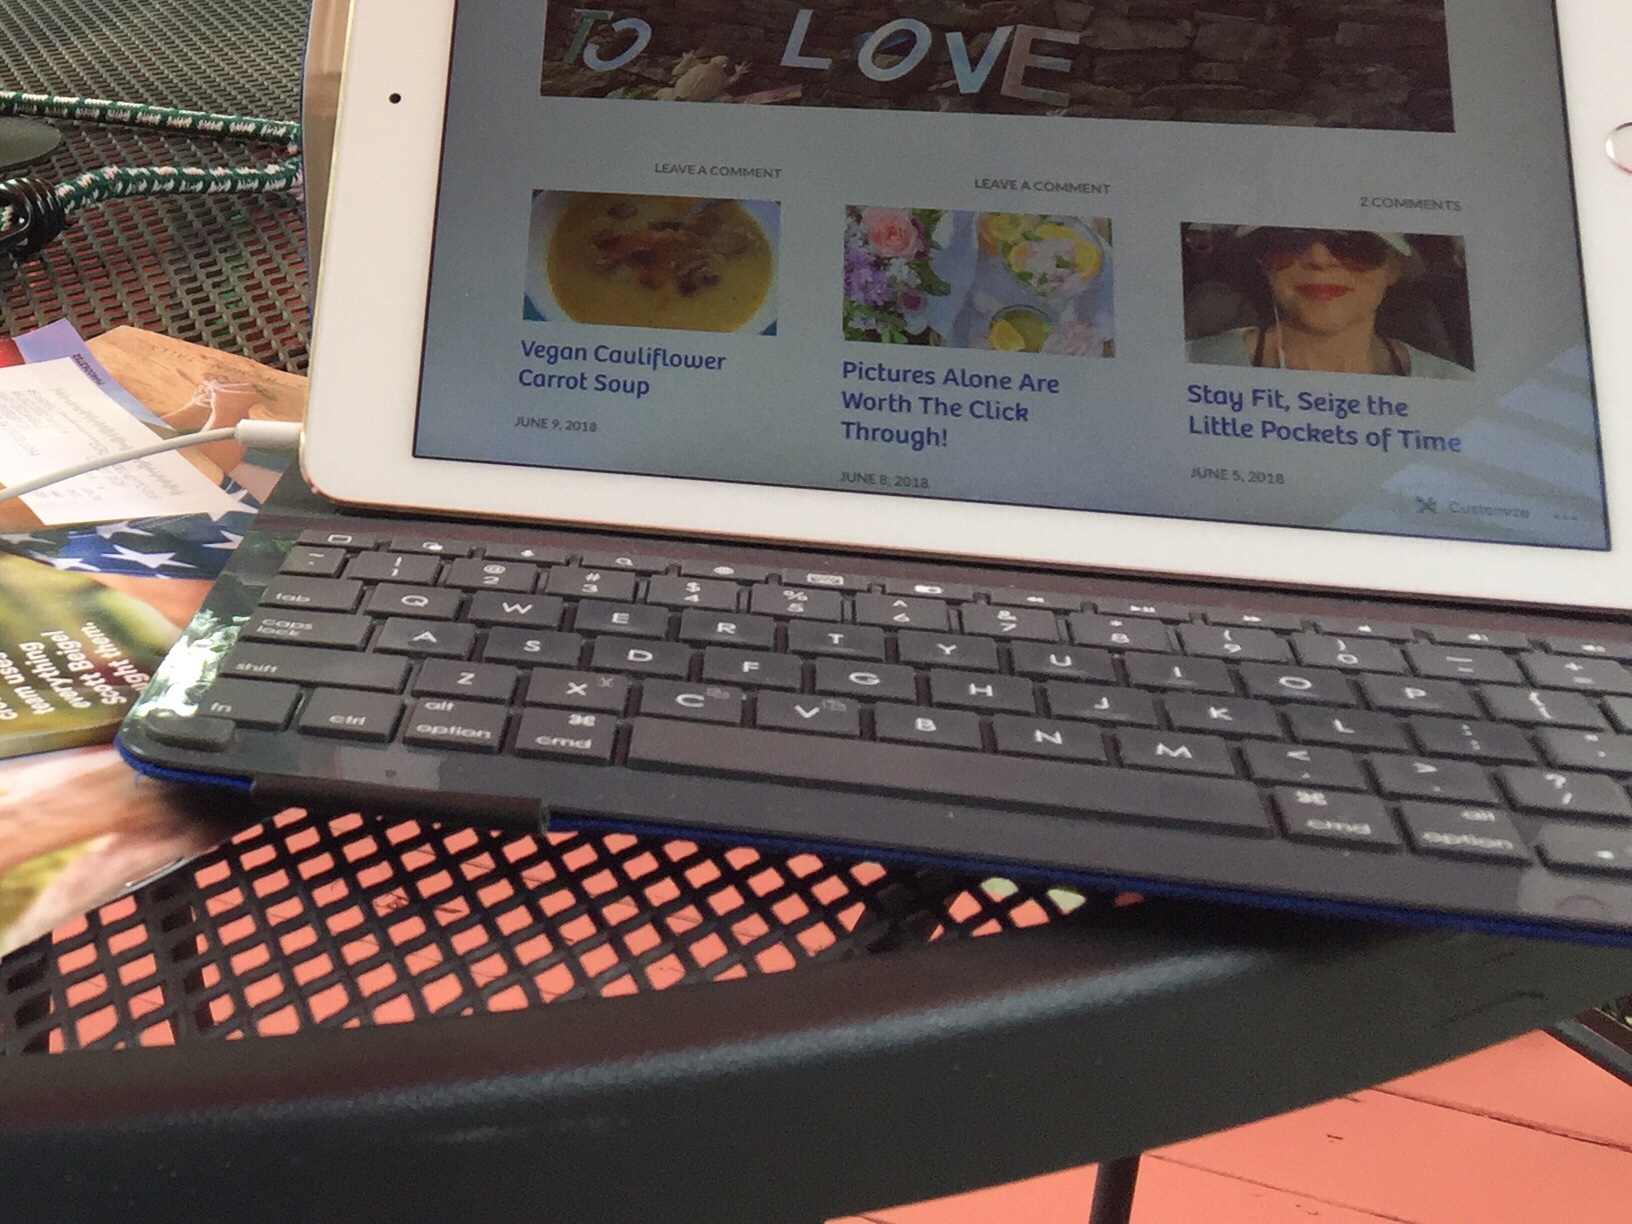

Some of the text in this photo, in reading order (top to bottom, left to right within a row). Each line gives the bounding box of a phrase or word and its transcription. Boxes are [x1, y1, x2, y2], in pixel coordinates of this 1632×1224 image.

[779, 8, 1081, 106] LOVE
[655, 163, 782, 178] LEAVE A COMMENT
[974, 179, 1110, 194] LEAVE A COMMENT
[1360, 196, 1462, 212] 2 COMMENTS
[521, 340, 726, 371] Vegan Cauliflower
[519, 368, 650, 398] Carrot Soup
[842, 361, 1060, 394] Pictures Alone Are
[841, 391, 1029, 422] Worth The Click
[1187, 384, 1409, 419] Stay Fit, Seize the
[515, 416, 548, 428] JUNE
[565, 420, 597, 432] 2018
[841, 421, 948, 451] Through!
[1189, 415, 1463, 453] Little Pockets of Time
[841, 471, 876, 485] JUNE
[894, 476, 929, 489] 2018
[1190, 466, 1229, 481] JUNE
[1248, 470, 1285, 485] 2018
[81, 621, 123, 659] them.
[256, 625, 301, 639] lock
[276, 592, 311, 603] tab
[401, 594, 429, 609] Q
[502, 601, 533, 615] W
[611, 612, 631, 624] E
[716, 621, 737, 635] R
[827, 633, 845, 645] T
[936, 642, 957, 655] Y
[1048, 653, 1073, 667] U
[1279, 676, 1313, 690] O
[1404, 687, 1427, 699] P
[19, 641, 92, 709] everything
[40, 630, 127, 706] Scott Beigel
[261, 617, 1356, 735] caps A S D F G H J K L
[14, 685, 56, 715] team
[209, 699, 456, 727] fn ctrl alt
[234, 659, 1193, 759] shift Z X C V B N M
[416, 724, 593, 750] option cmd
[1305, 817, 1515, 852] cmd option
